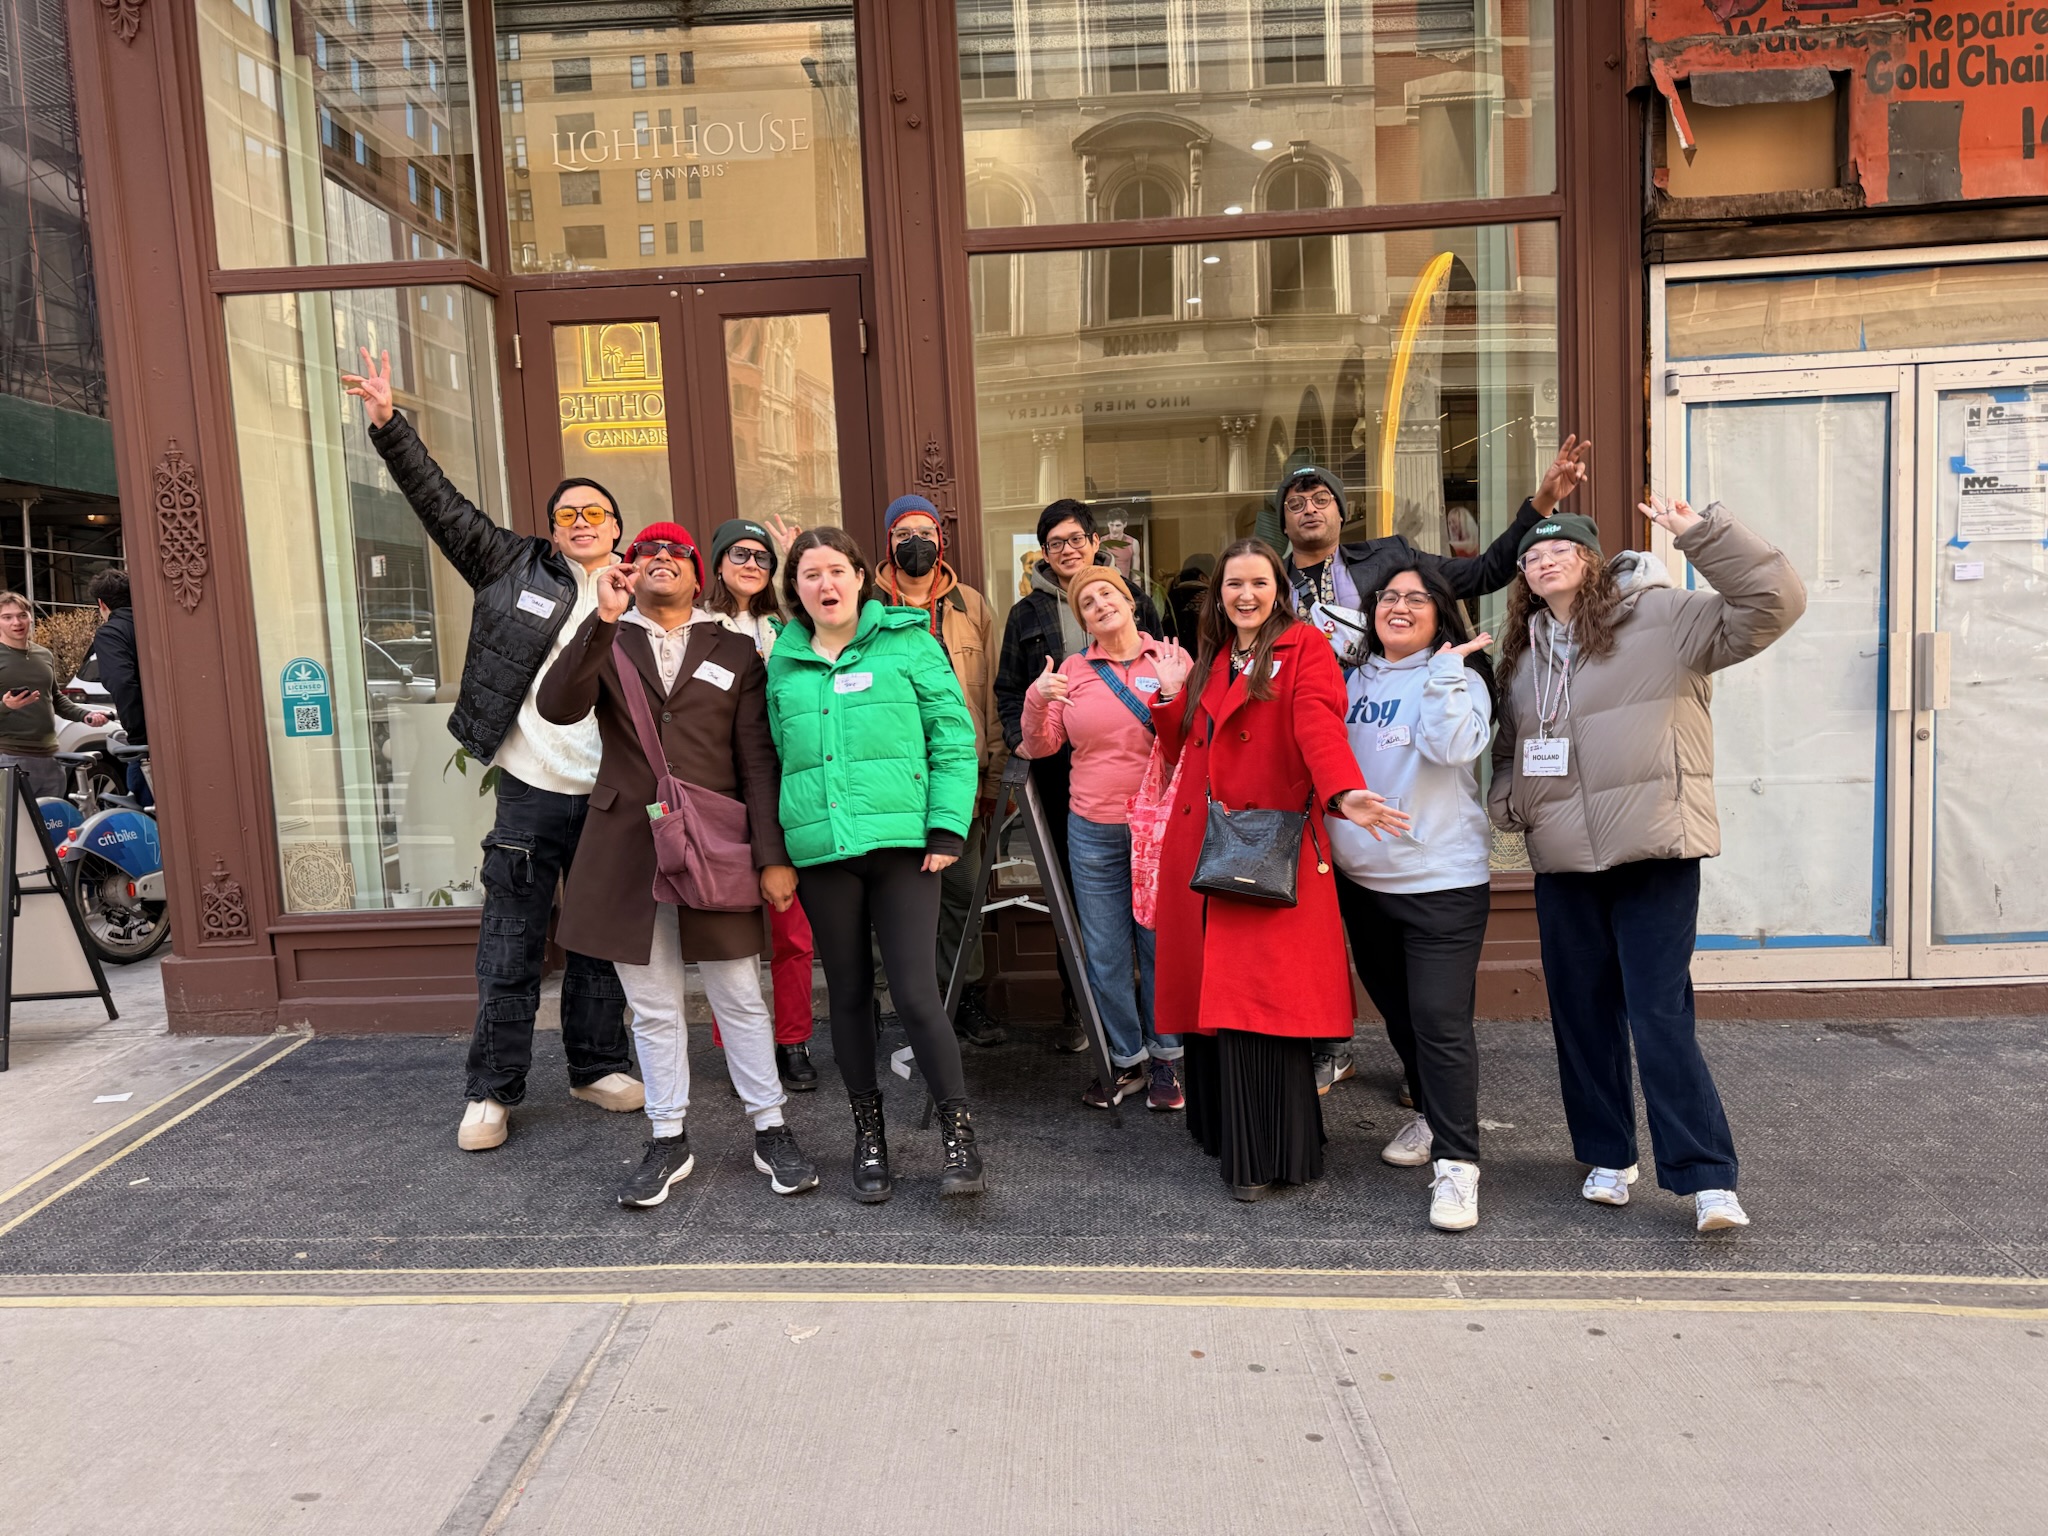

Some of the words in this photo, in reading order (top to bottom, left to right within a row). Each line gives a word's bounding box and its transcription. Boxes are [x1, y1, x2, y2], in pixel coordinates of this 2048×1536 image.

[1866, 48, 1950, 94] Gold
[1957, 43, 2048, 87] Chai
[550, 112, 811, 172] LIGHTHOUSE
[640, 163, 725, 181] CANNABIS
[586, 428, 669, 447] CANNABIS
[1963, 476, 1999, 489] NYC
[287, 683, 322, 691] LICENSED
[1346, 694, 1402, 729] foy
[44, 818, 63, 830] bike
